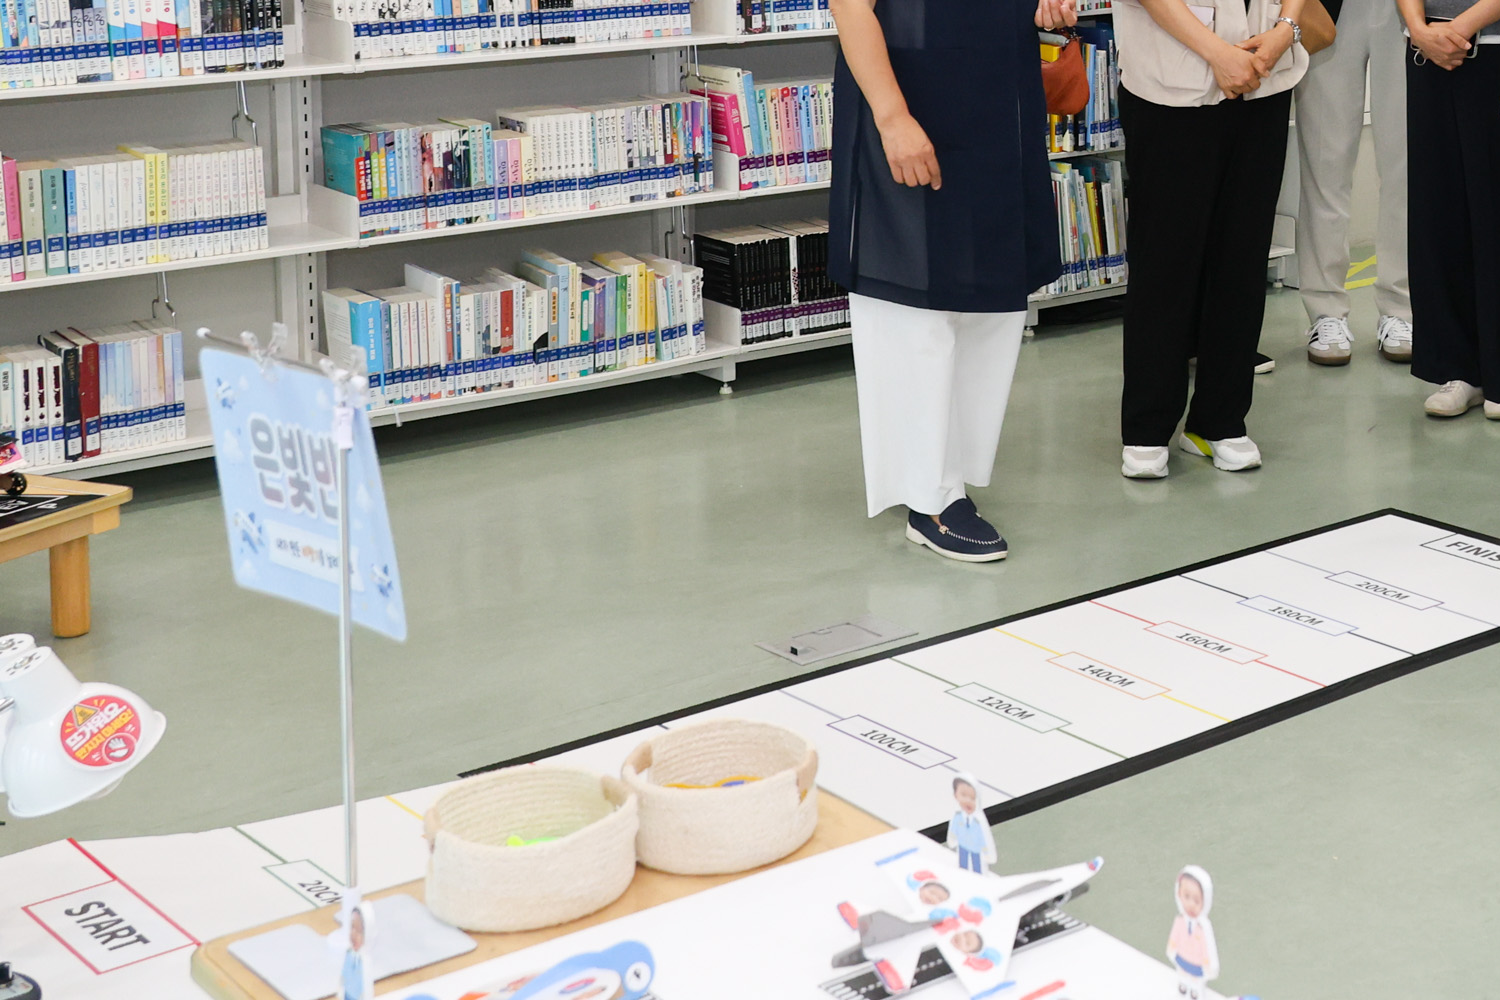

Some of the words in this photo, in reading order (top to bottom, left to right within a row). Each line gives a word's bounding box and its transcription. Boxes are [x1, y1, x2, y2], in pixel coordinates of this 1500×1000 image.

[1354, 578, 1411, 603] 200CM
[1269, 604, 1325, 628] 180CM
[1176, 630, 1233, 655] 160CM
[1079, 662, 1135, 690] 140CM
[977, 693, 1035, 723] 120CM
[65, 702, 128, 752] 뜨거워요
[858, 727, 920, 757] 100CM
[63, 899, 151, 952] START
